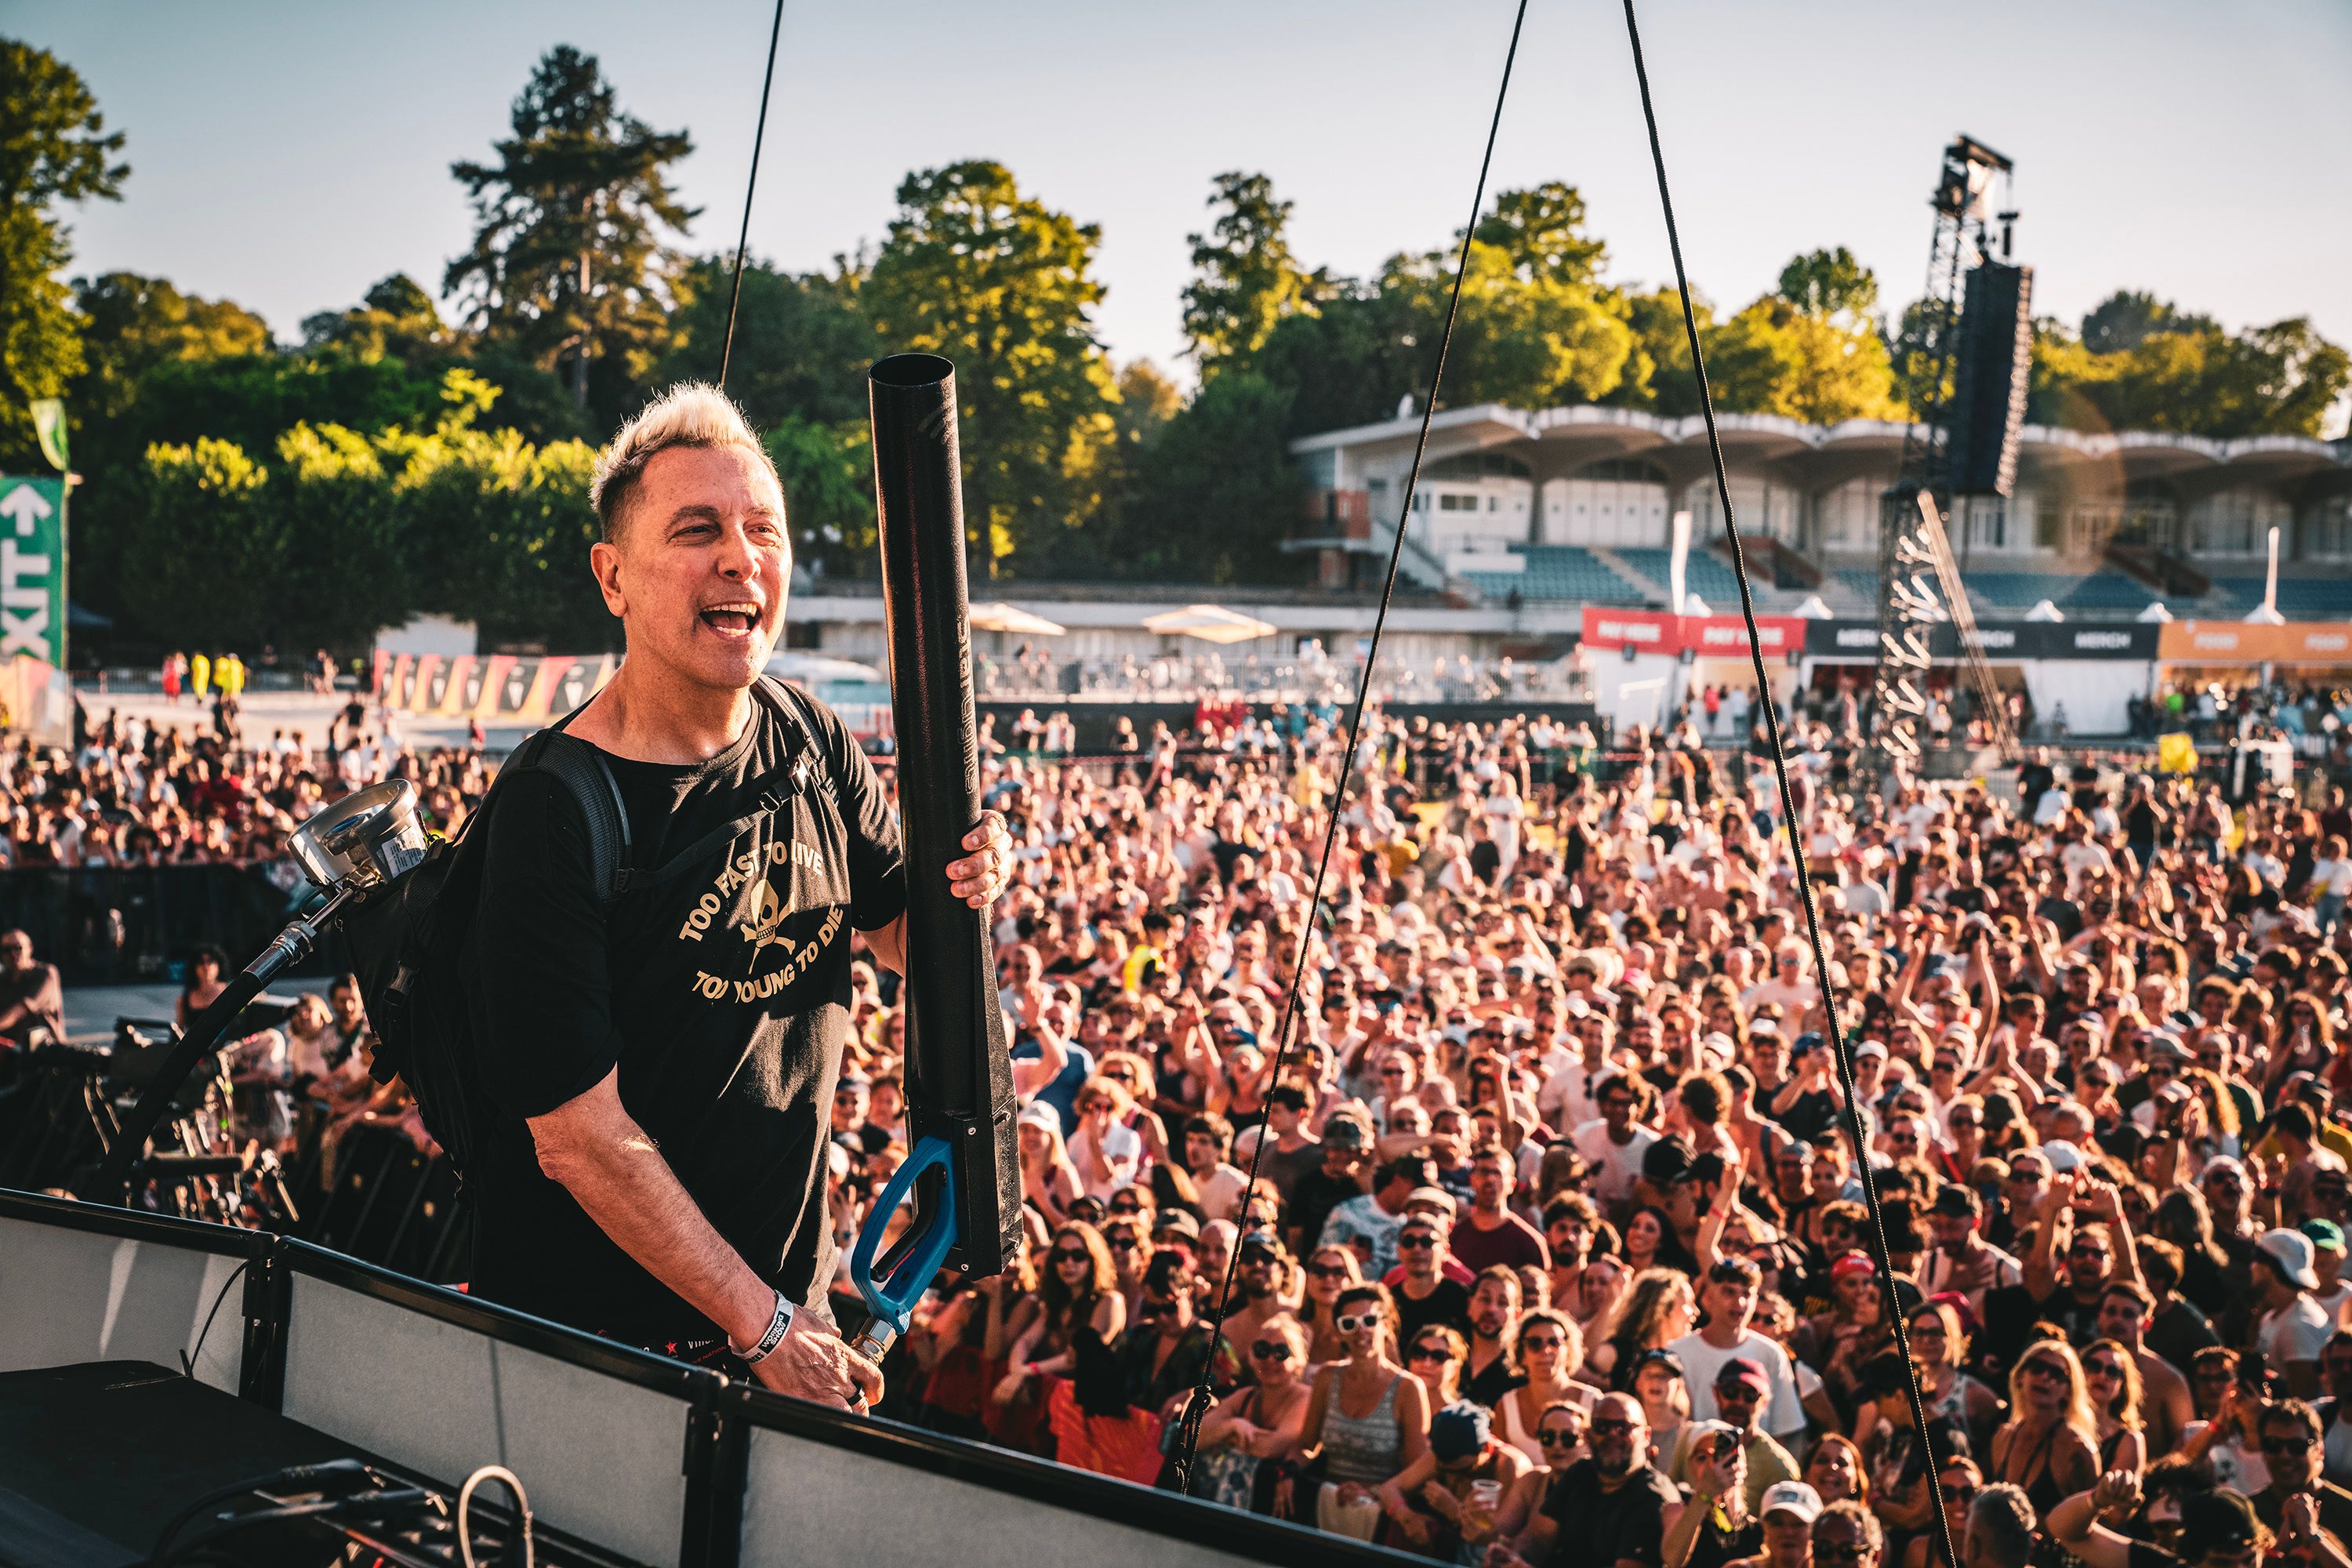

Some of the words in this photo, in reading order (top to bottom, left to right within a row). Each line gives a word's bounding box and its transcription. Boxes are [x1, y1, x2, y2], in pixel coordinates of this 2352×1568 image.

[0, 538, 51, 663] XIT
[1598, 621, 1623, 639] PAY
[1625, 624, 1661, 643] HERE
[1703, 626, 1735, 644] PAY
[1737, 628, 1784, 646] HRE
[1837, 629, 1879, 648] MERC
[2075, 632, 2131, 649] MERCH
[2194, 633, 2238, 650] FOOD
[679, 892, 721, 942] TOO
[713, 849, 760, 899] FAST
[762, 840, 788, 866] TO
[791, 838, 824, 877] LIVE
[795, 940, 819, 972] TO
[818, 900, 844, 948] DIE
[761, 1314, 785, 1348] WORKING
[770, 1322, 786, 1345] SHOW
